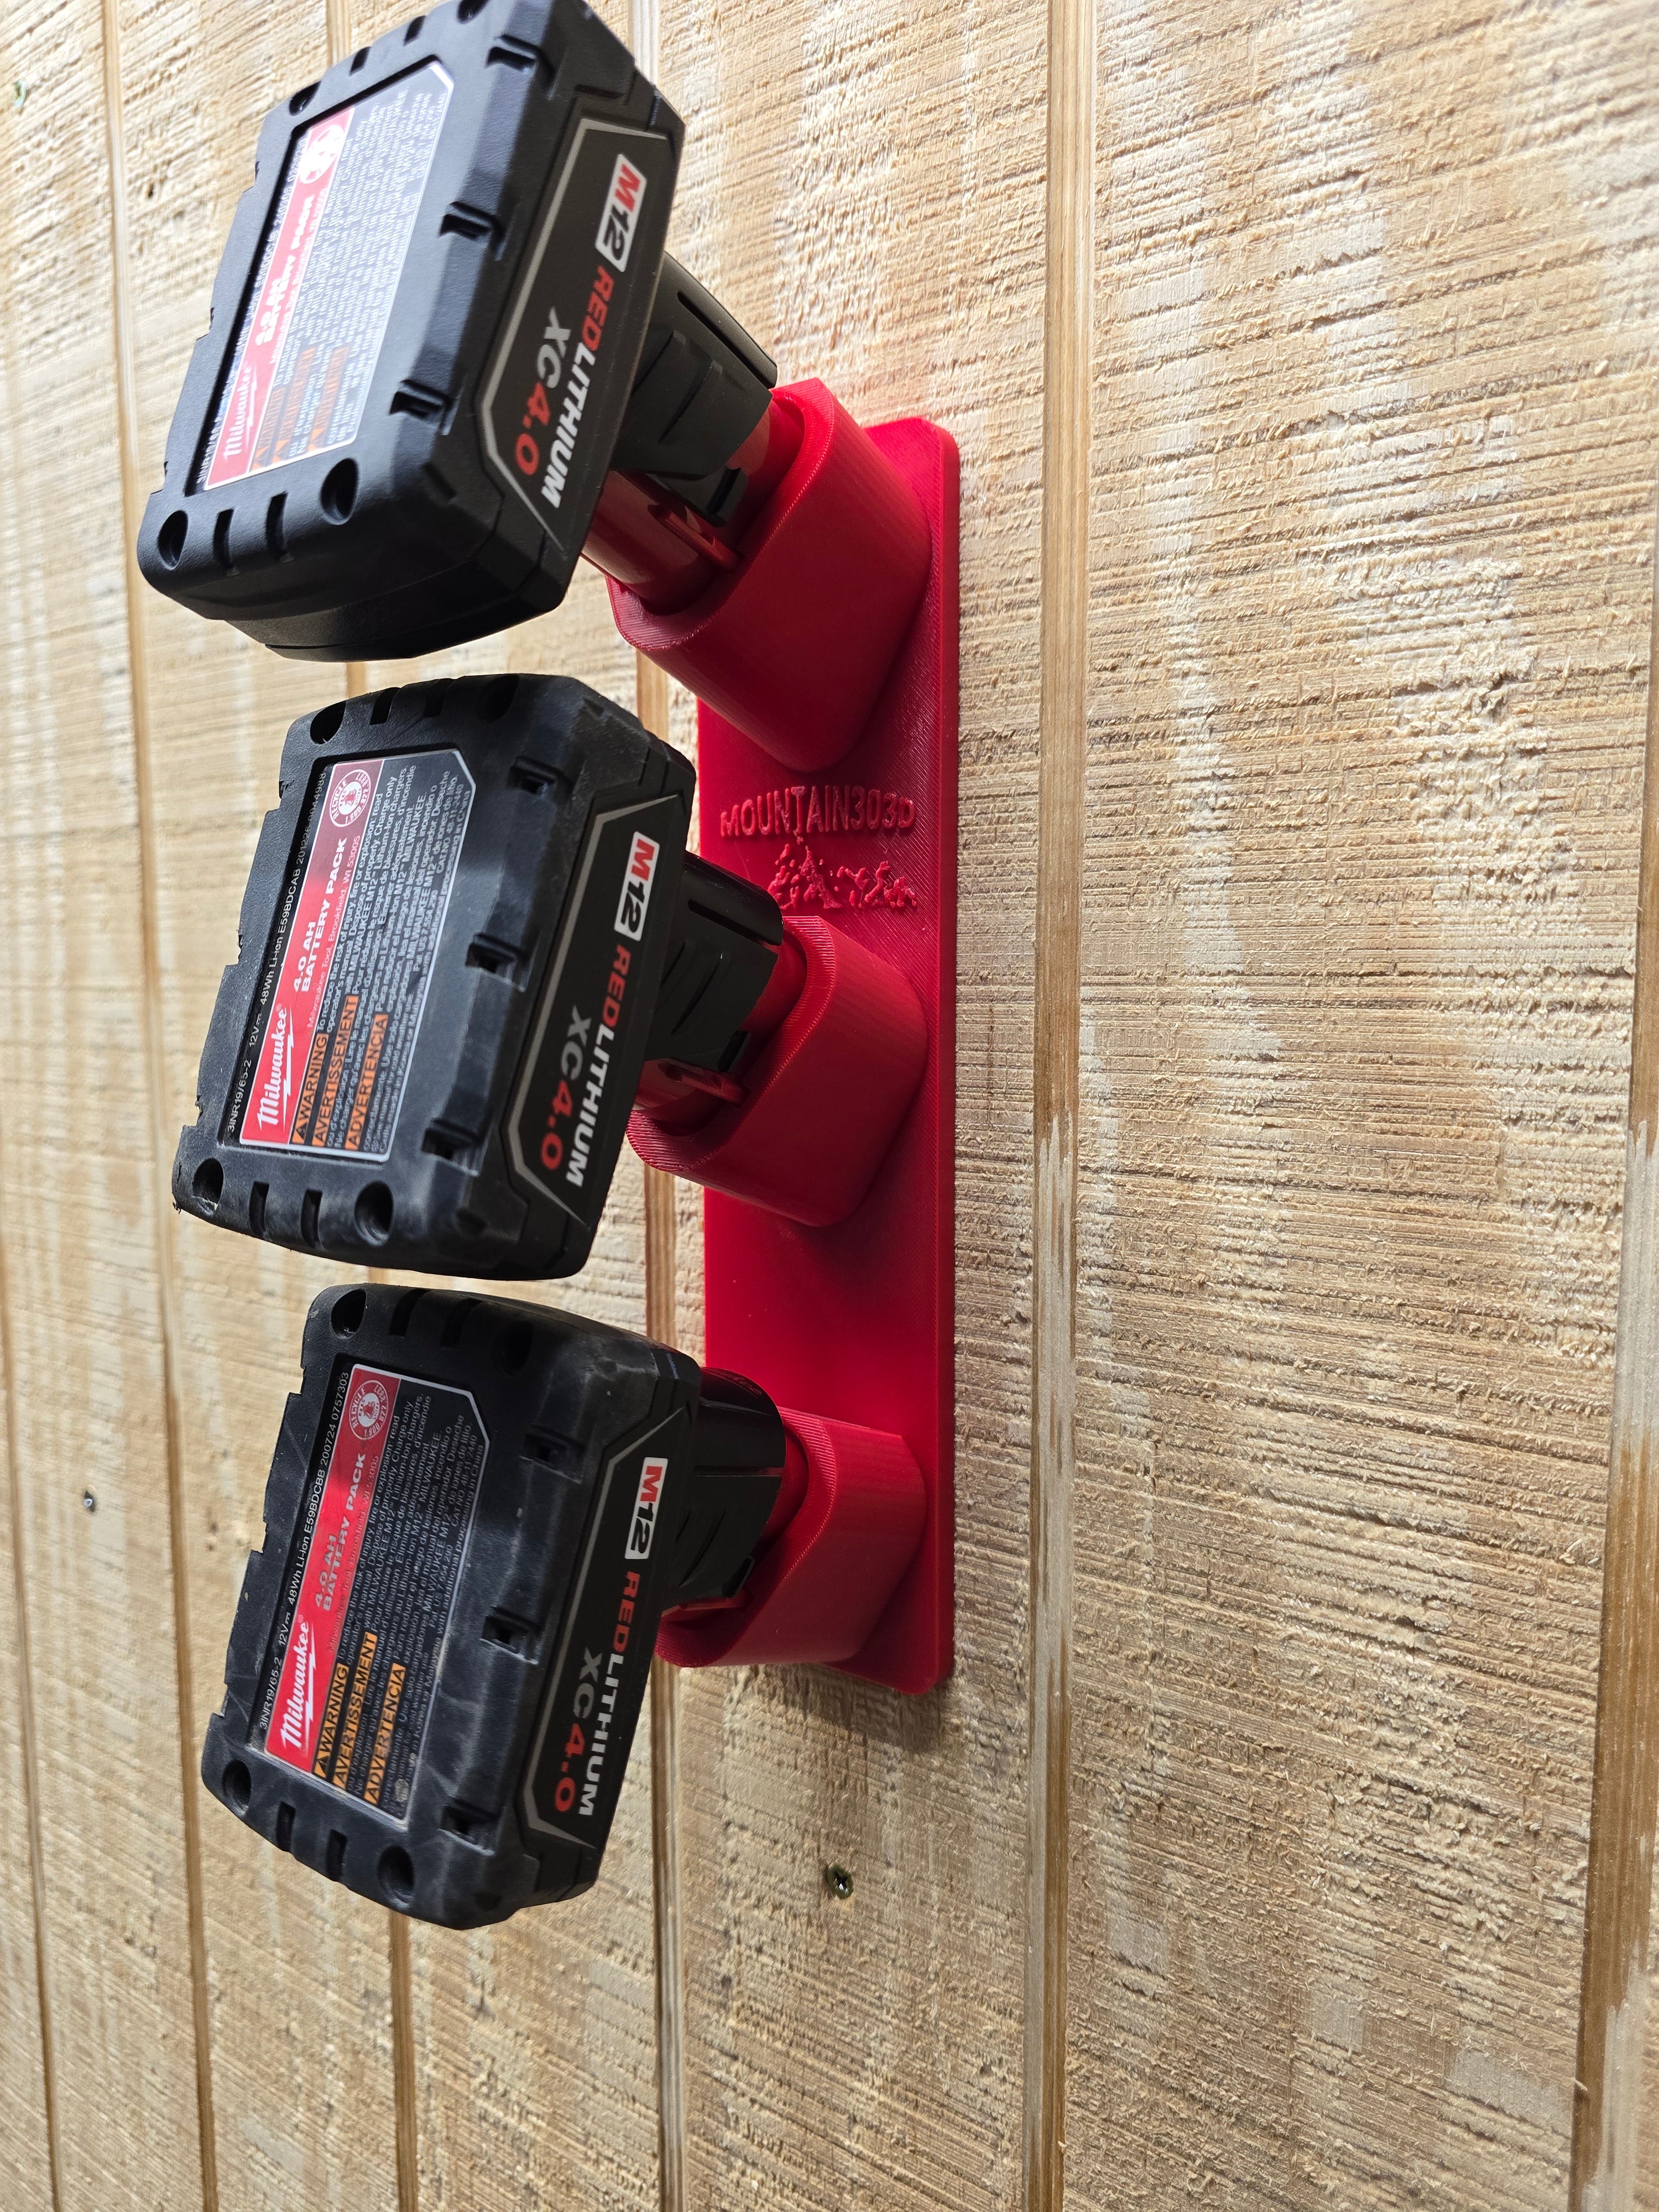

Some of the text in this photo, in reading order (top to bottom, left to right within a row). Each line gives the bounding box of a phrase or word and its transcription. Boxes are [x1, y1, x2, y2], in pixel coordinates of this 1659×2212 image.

[603, 163, 641, 262] M12
[327, 779, 348, 820] RECYCLE
[371, 793, 384, 816] read
[347, 835, 362, 867] 53005
[348, 894, 367, 935] Dispose
[359, 883, 370, 892] of
[373, 799, 391, 835] Charge
[383, 776, 397, 797] only
[343, 869, 353, 883] WI
[349, 881, 362, 898] fire
[354, 870, 364, 880] or
[620, 838, 655, 934] M12
[300, 837, 348, 992] BATTERY PACK
[351, 968, 365, 994] Pour
[367, 919, 378, 928] le
[378, 870, 390, 884] de
[291, 921, 316, 992] 4.0 AH
[333, 943, 346, 962] risk
[338, 931, 349, 941] of
[348, 902, 373, 971] MILWAUKEE
[259, 971, 275, 1005] 48Wh
[328, 963, 341, 979] the
[342, 972, 355, 994] with
[306, 971, 327, 1027] Milwaukee
[319, 981, 336, 1018] reduce
[316, 1018, 326, 1031] To
[296, 1036, 329, 1121] WARNING
[312, 999, 359, 1142] AVERTISSEMENT
[345, 1018, 388, 1146] ADVERTENCIA
[347, 1385, 367, 1428] RECYCLE
[388, 1415, 400, 1438] read
[368, 1506, 378, 1524] fire
[372, 1494, 381, 1505] or
[630, 1465, 663, 1553] M12
[258, 1656, 282, 1730] 3INR19/65-2
[287, 1569, 302, 1605] 48Wh
[304, 1468, 325, 1533] E59BDCBB
[320, 1423, 336, 1466] 200724
[330, 1371, 348, 1420] 0757303
[322, 1452, 366, 1611] BATTERY PACK
[345, 1611, 364, 1666] operator's
[367, 1522, 384, 1566] Dispose
[377, 1510, 387, 1521] of
[390, 1423, 406, 1462] Charge
[399, 1400, 411, 1422] only
[314, 1534, 336, 1607] 4.0 AH
[353, 1569, 364, 1589] risk
[358, 1558, 367, 1568] of
[367, 1533, 390, 1605] MILWAUKEE
[349, 1589, 359, 1608] the
[362, 1605, 374, 1629] with
[340, 1609, 355, 1647] reduce
[319, 1665, 348, 1754] WARNING
[334, 1634, 376, 1784] AVERTISSEMENT
[366, 1666, 405, 1801] ADVERTENCIA
